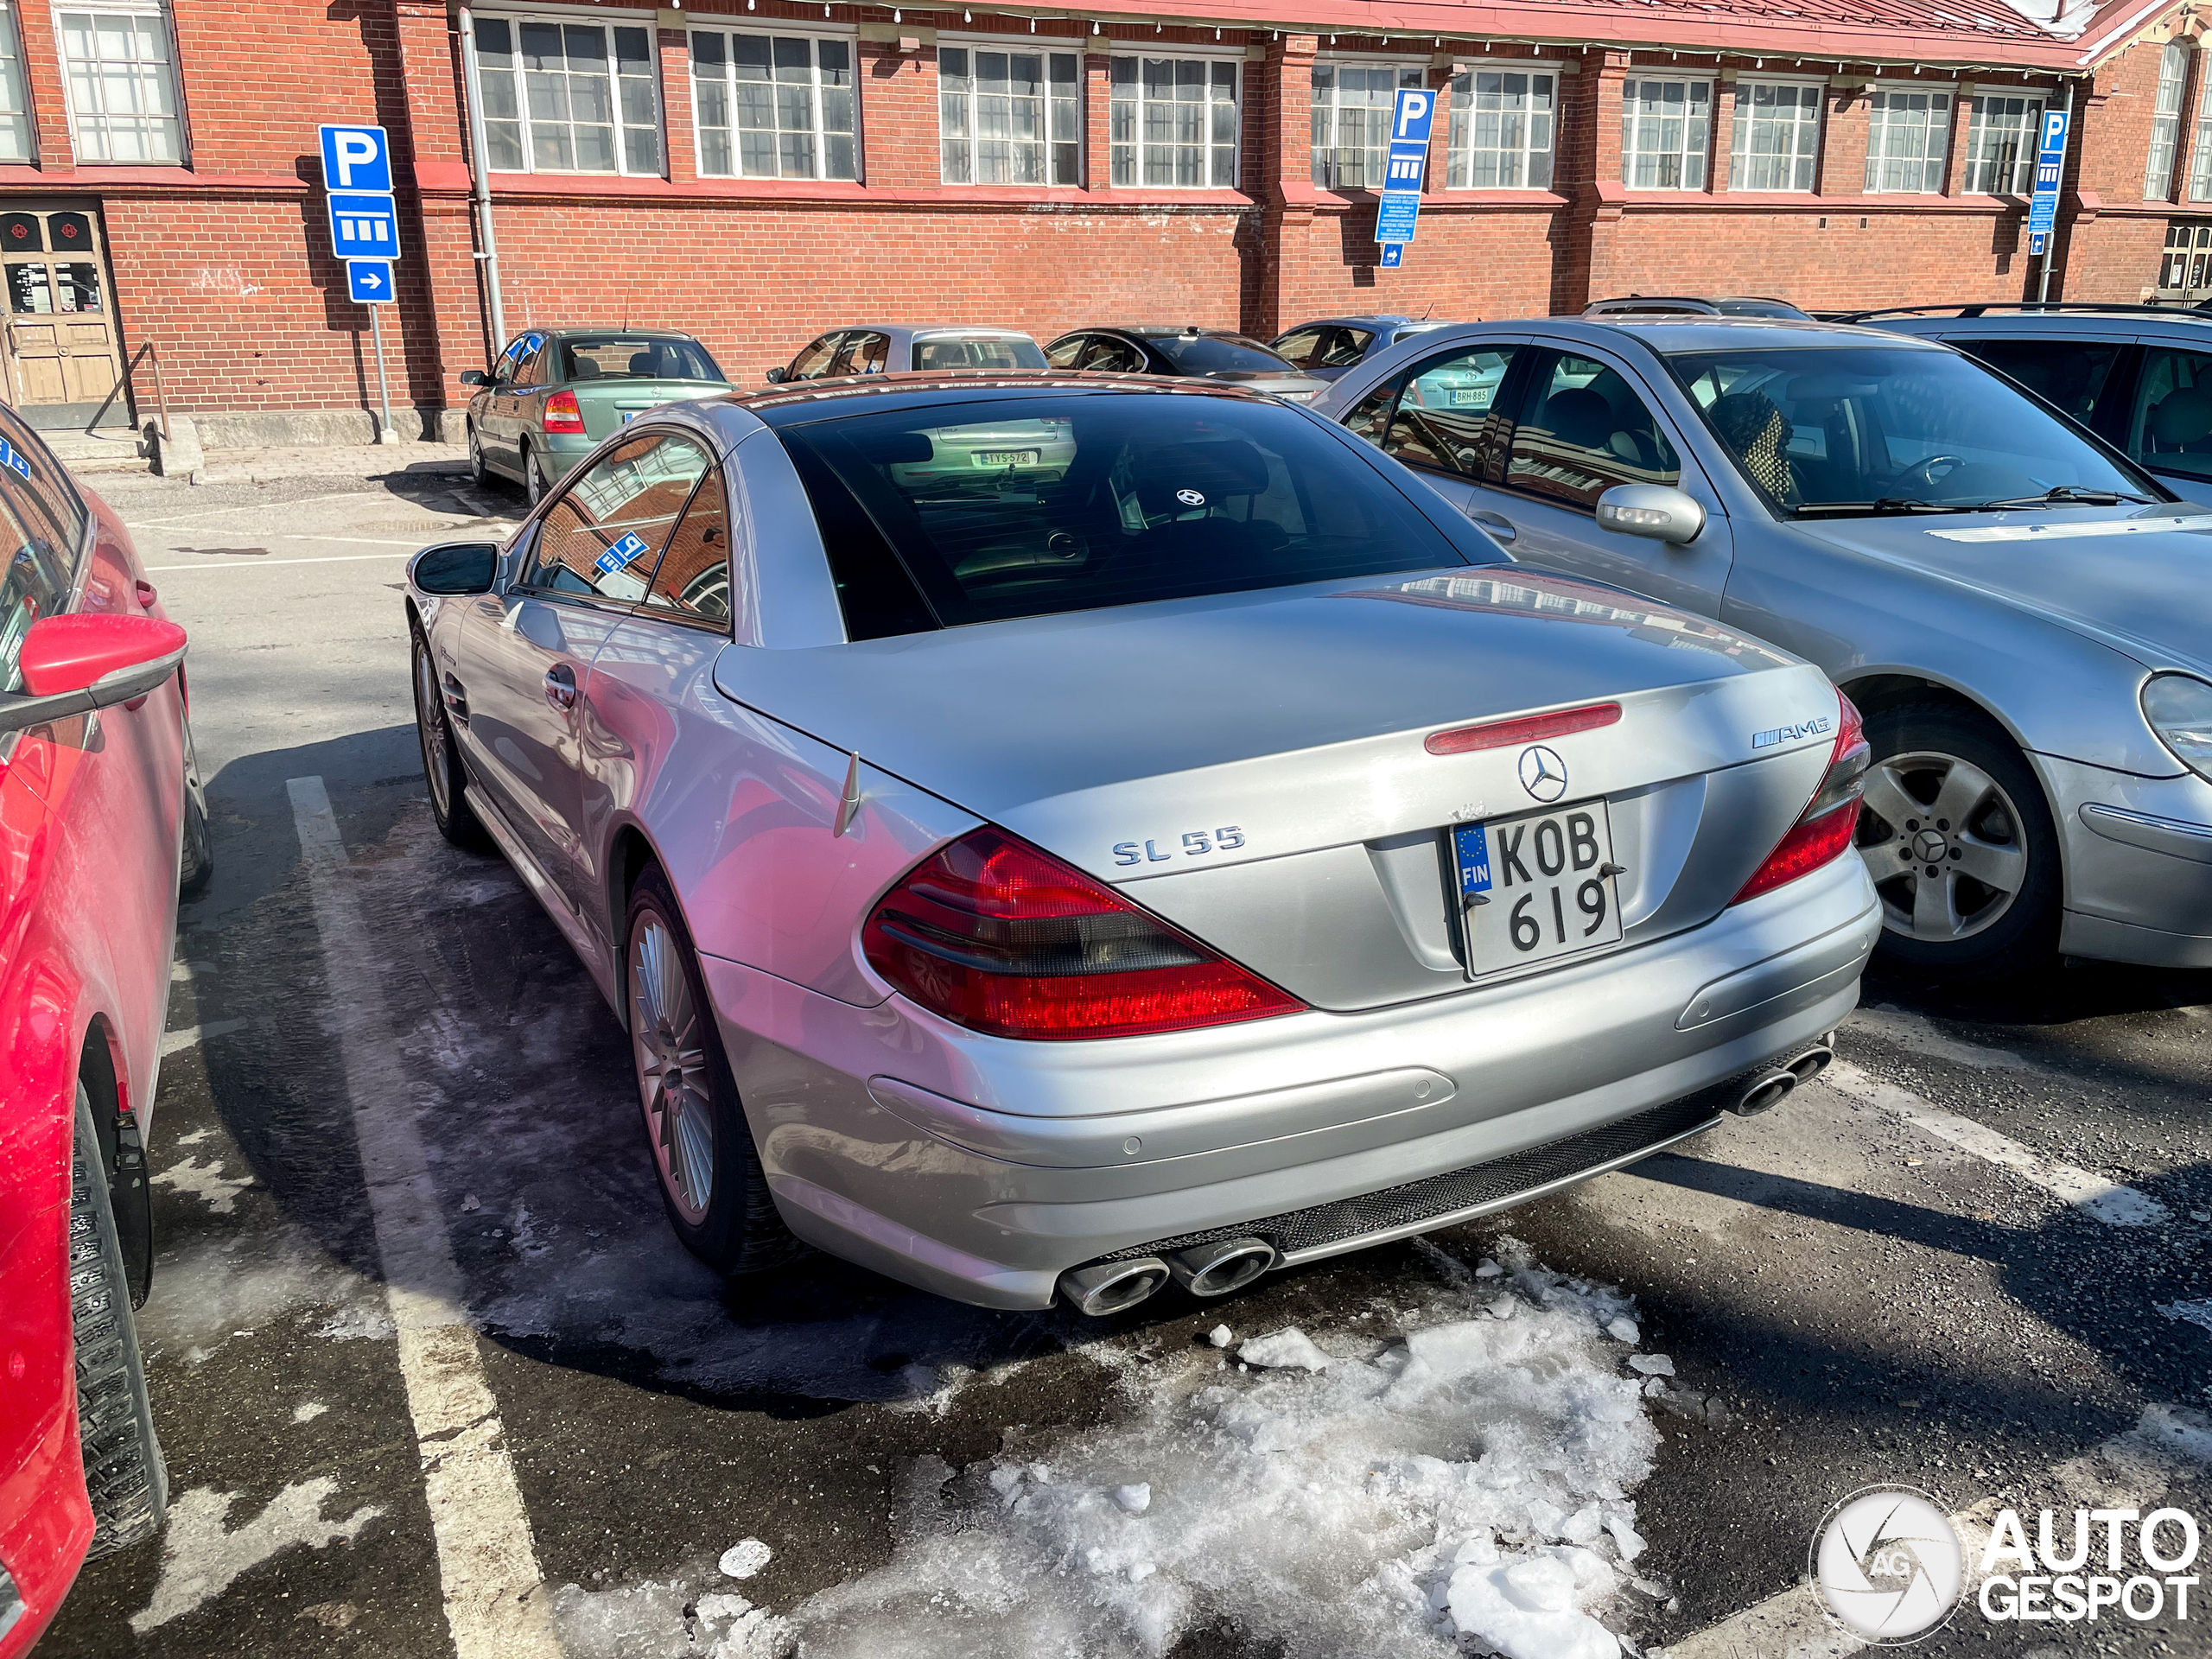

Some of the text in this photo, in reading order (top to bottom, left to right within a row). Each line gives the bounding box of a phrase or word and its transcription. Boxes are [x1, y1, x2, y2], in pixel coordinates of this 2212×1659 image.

[1398, 93, 1427, 137] P
[2044, 114, 2064, 149] P
[334, 130, 378, 187] P
[1457, 391, 1486, 402] BRH-885
[988, 453, 1027, 462] TYS-572
[1112, 825, 1246, 866] SL 55
[1497, 811, 1599, 887] KOB
[1462, 863, 1489, 887] FIN
[1508, 877, 1607, 952] 619
